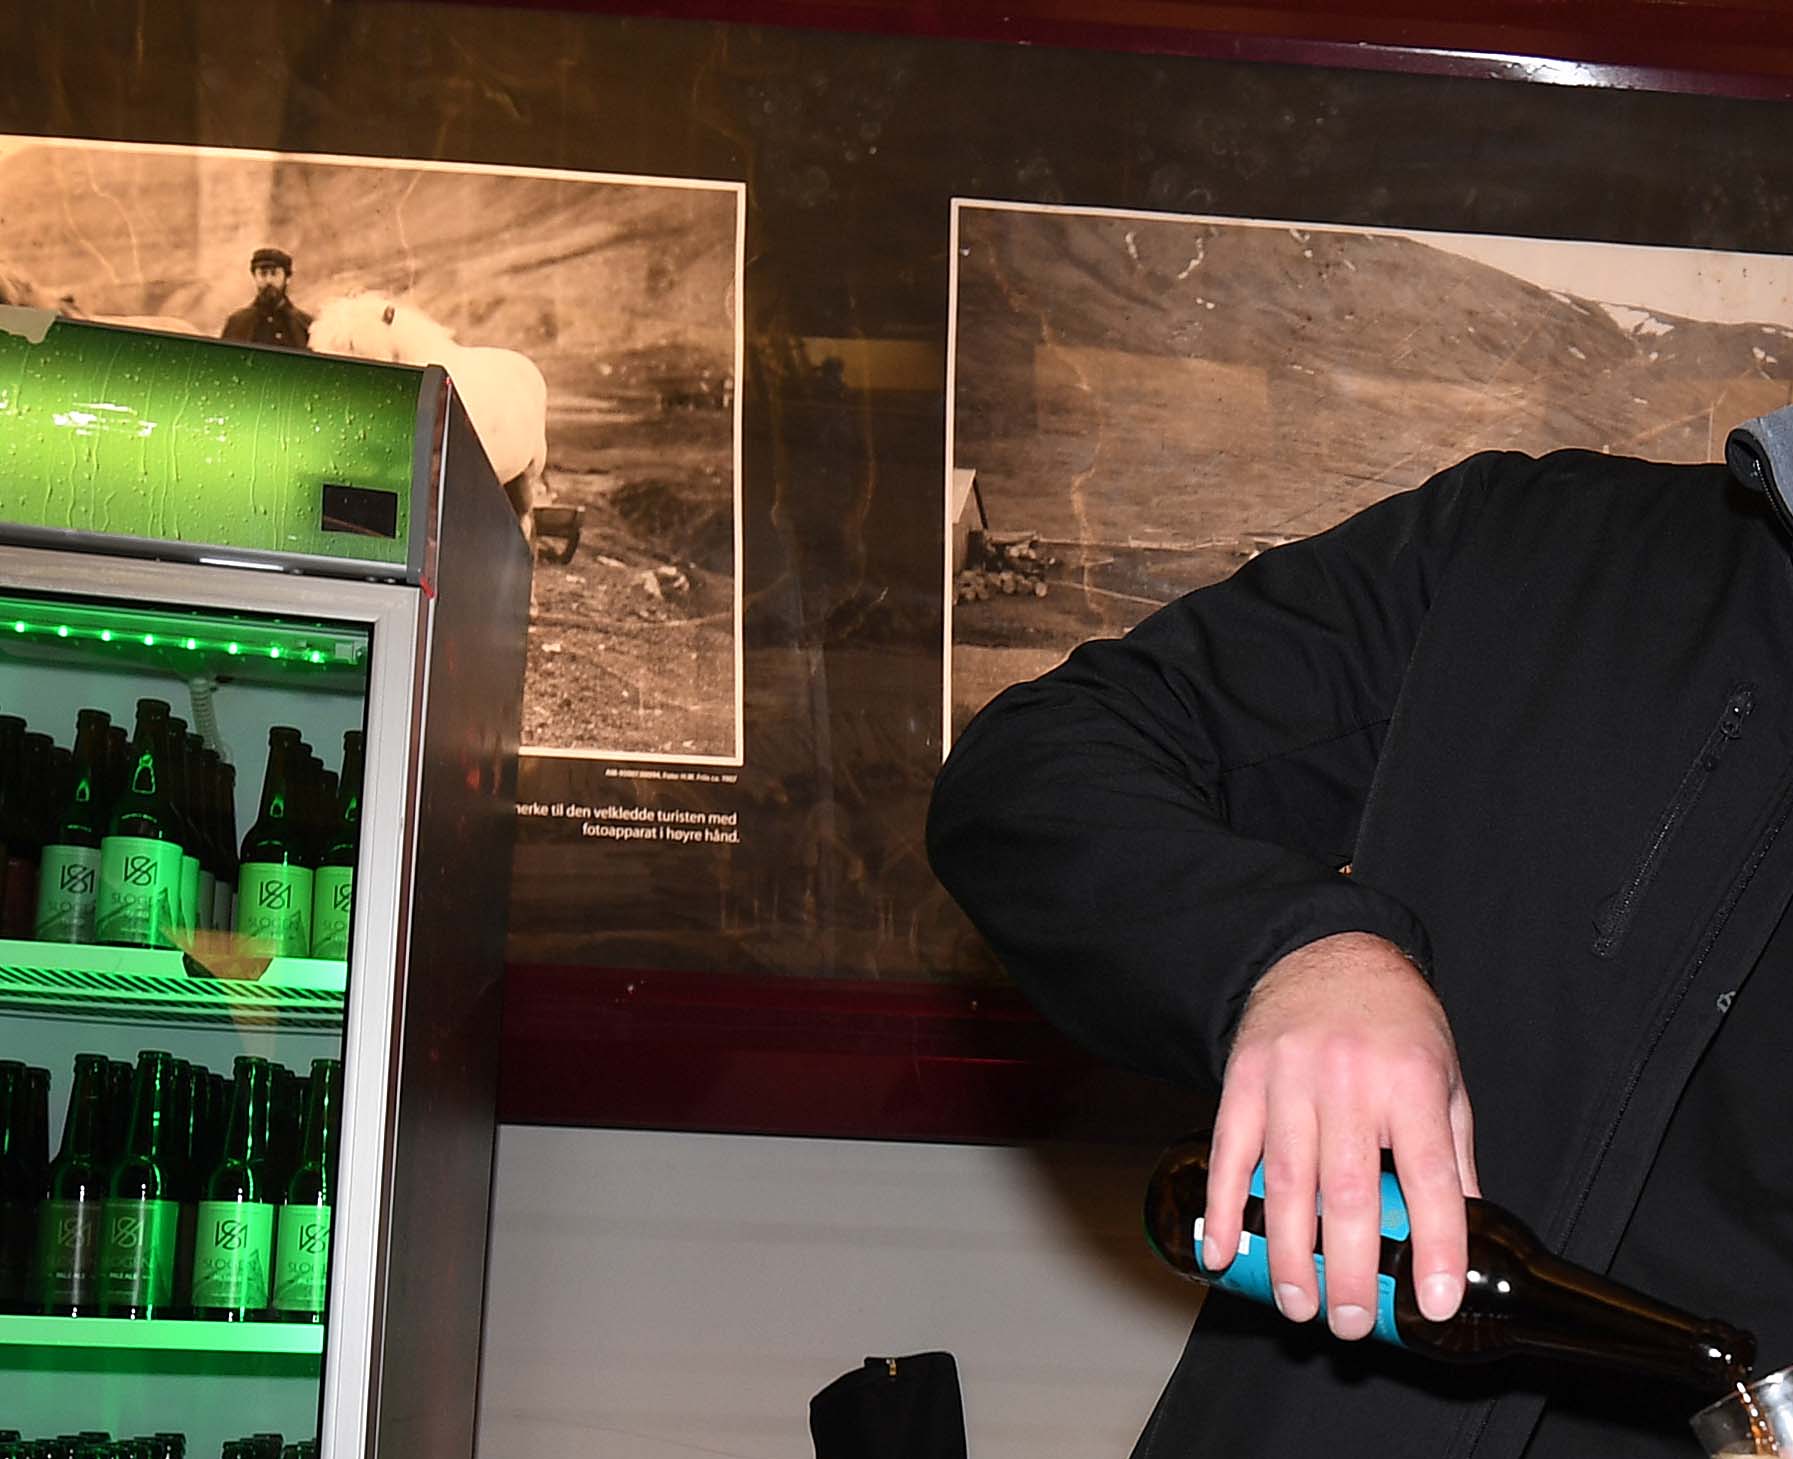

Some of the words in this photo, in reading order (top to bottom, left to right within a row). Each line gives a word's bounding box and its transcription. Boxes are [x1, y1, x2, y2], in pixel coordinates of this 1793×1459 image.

[551, 803, 564, 818] til
[566, 804, 591, 819] den
[593, 806, 655, 822] velkledde
[657, 809, 706, 824] turisten
[708, 812, 737, 826] med
[582, 822, 657, 840] fotoapparat
[666, 829, 702, 843] høyre
[704, 829, 740, 843] hånd.
